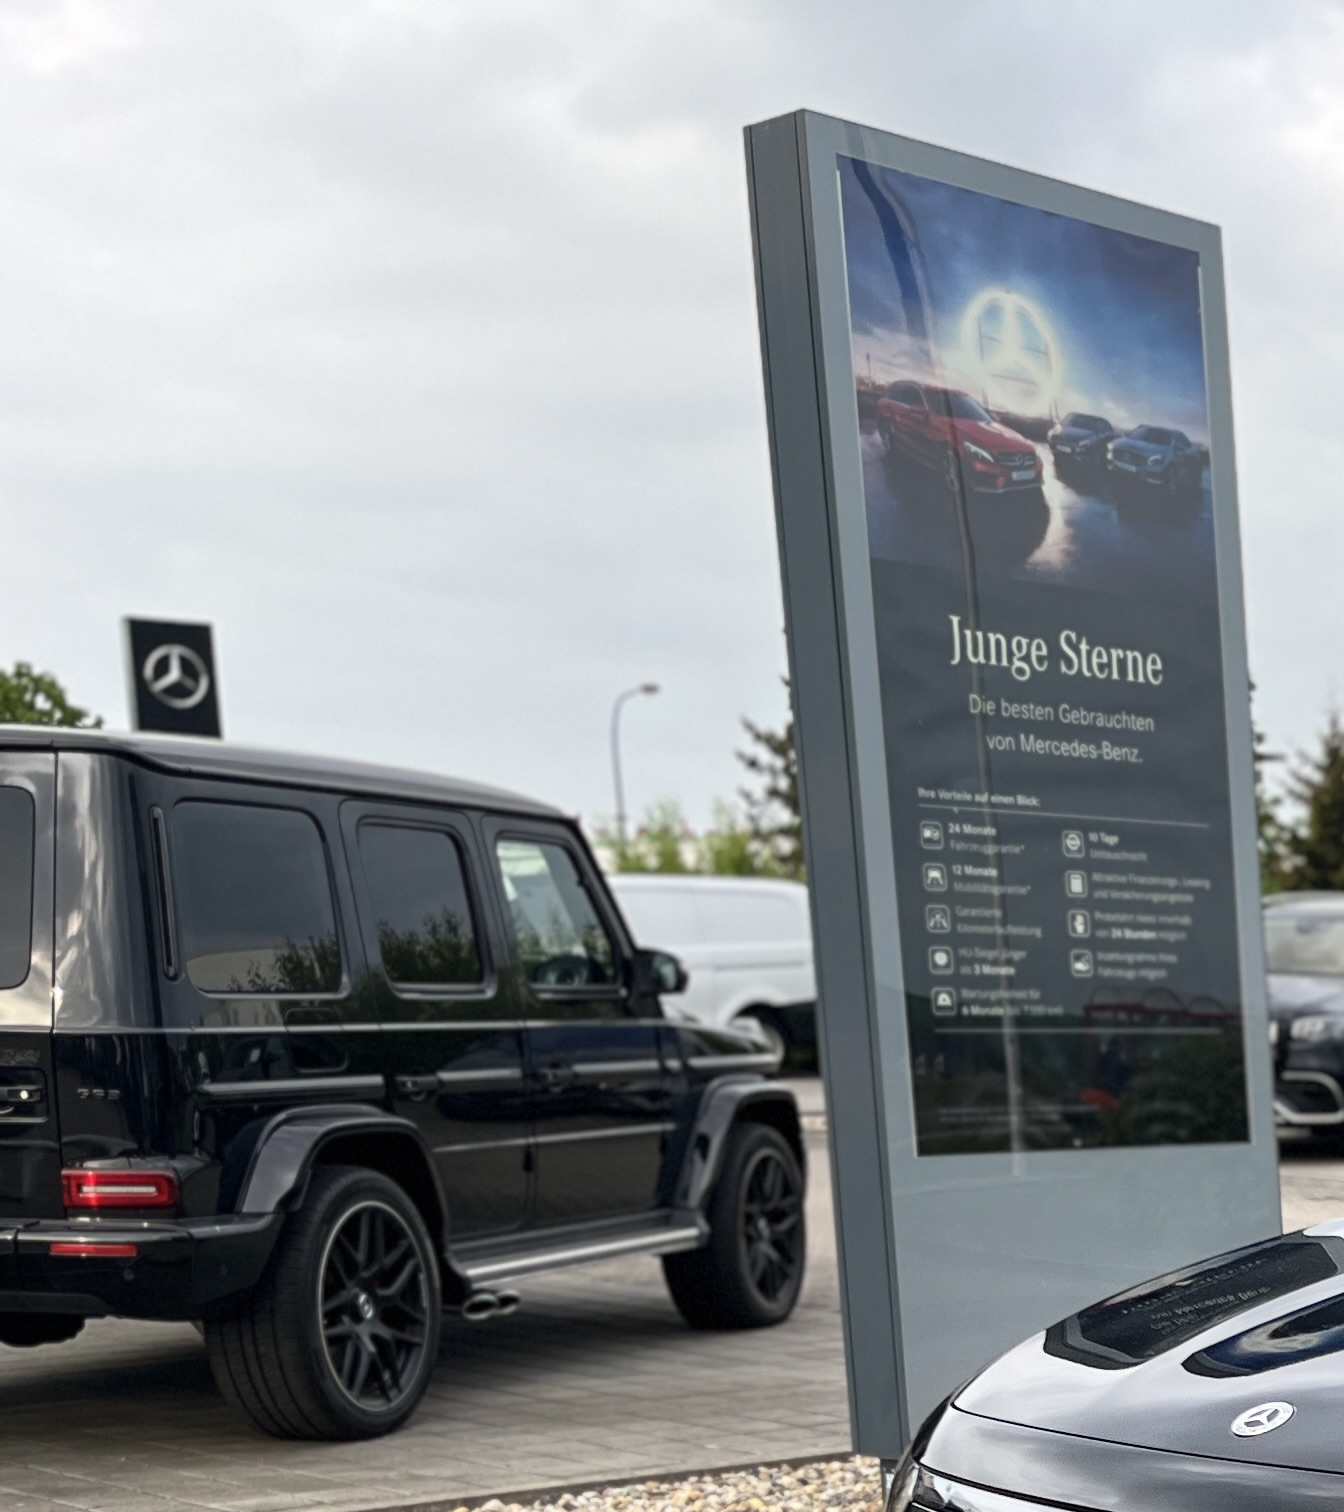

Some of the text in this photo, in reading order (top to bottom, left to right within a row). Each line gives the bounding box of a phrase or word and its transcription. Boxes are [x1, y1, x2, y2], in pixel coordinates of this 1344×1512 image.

[948, 614, 1163, 686] Junge Sterne
[968, 693, 1155, 732] Die besten Gebrauchten
[986, 732, 1143, 763] von Mercedes-Benz.
[937, 788, 972, 802] Vorteile
[948, 822, 997, 837] 24 Monate
[952, 864, 998, 878] 12 Monate
[982, 965, 1016, 976] Monate
